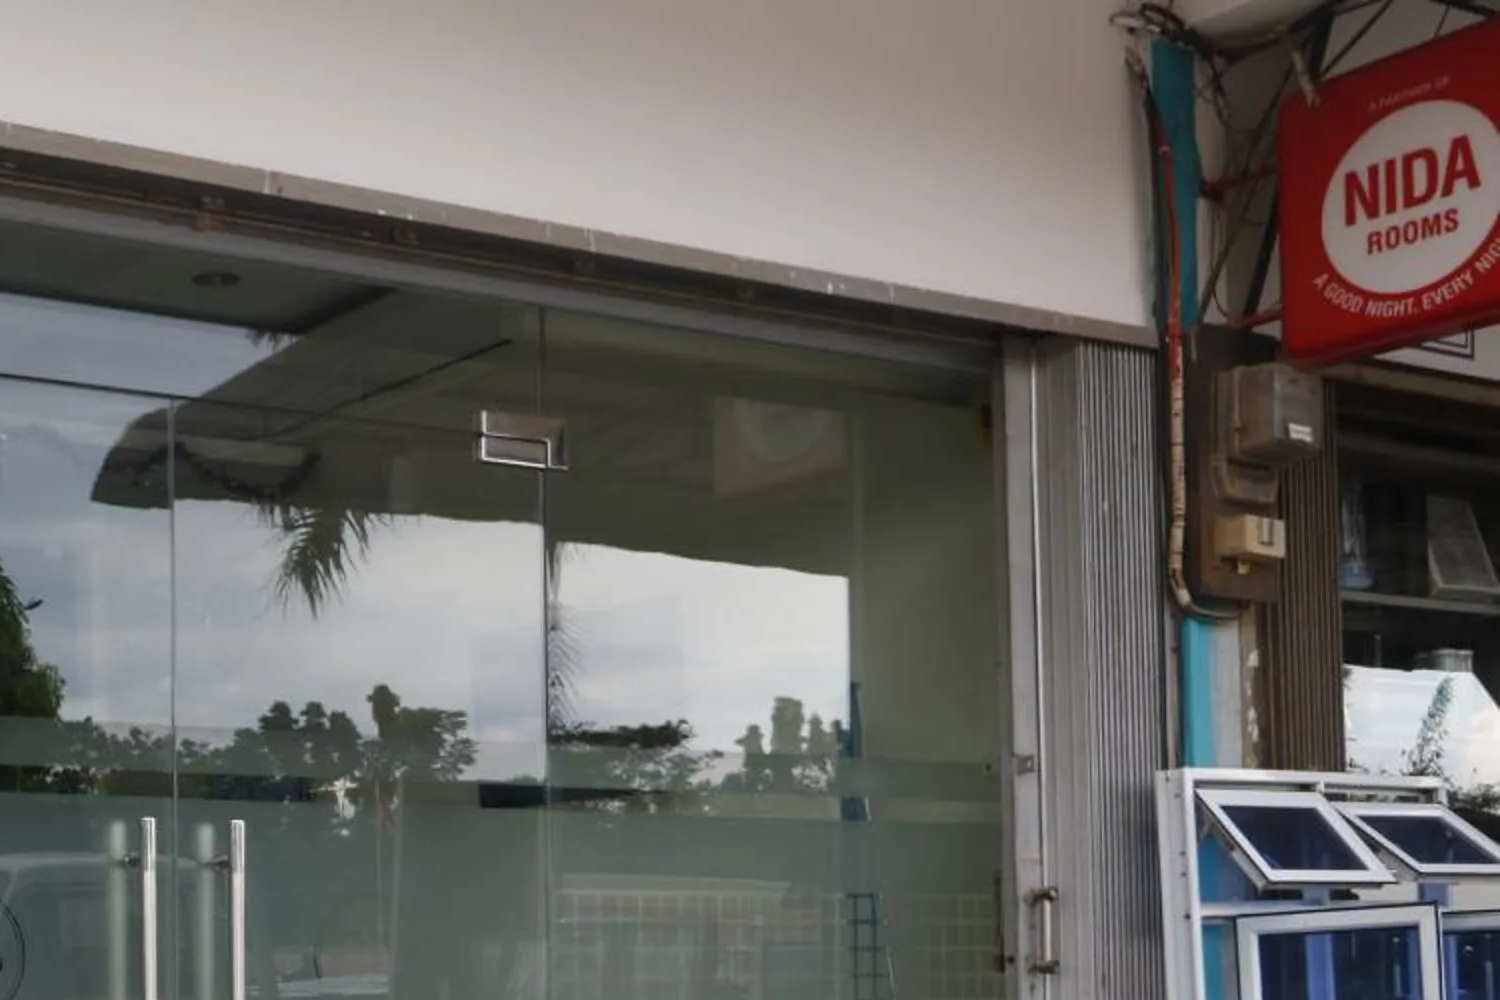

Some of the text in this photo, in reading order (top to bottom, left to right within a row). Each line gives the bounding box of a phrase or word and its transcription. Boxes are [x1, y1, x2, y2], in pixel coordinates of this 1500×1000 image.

[1344, 134, 1481, 227] NIDA
[1367, 208, 1460, 255] ROOMS
[1312, 273, 1330, 291] A
[1324, 282, 1364, 314] GOOD
[1421, 269, 1475, 311] EVERY
[1474, 238, 1500, 276] NIG
